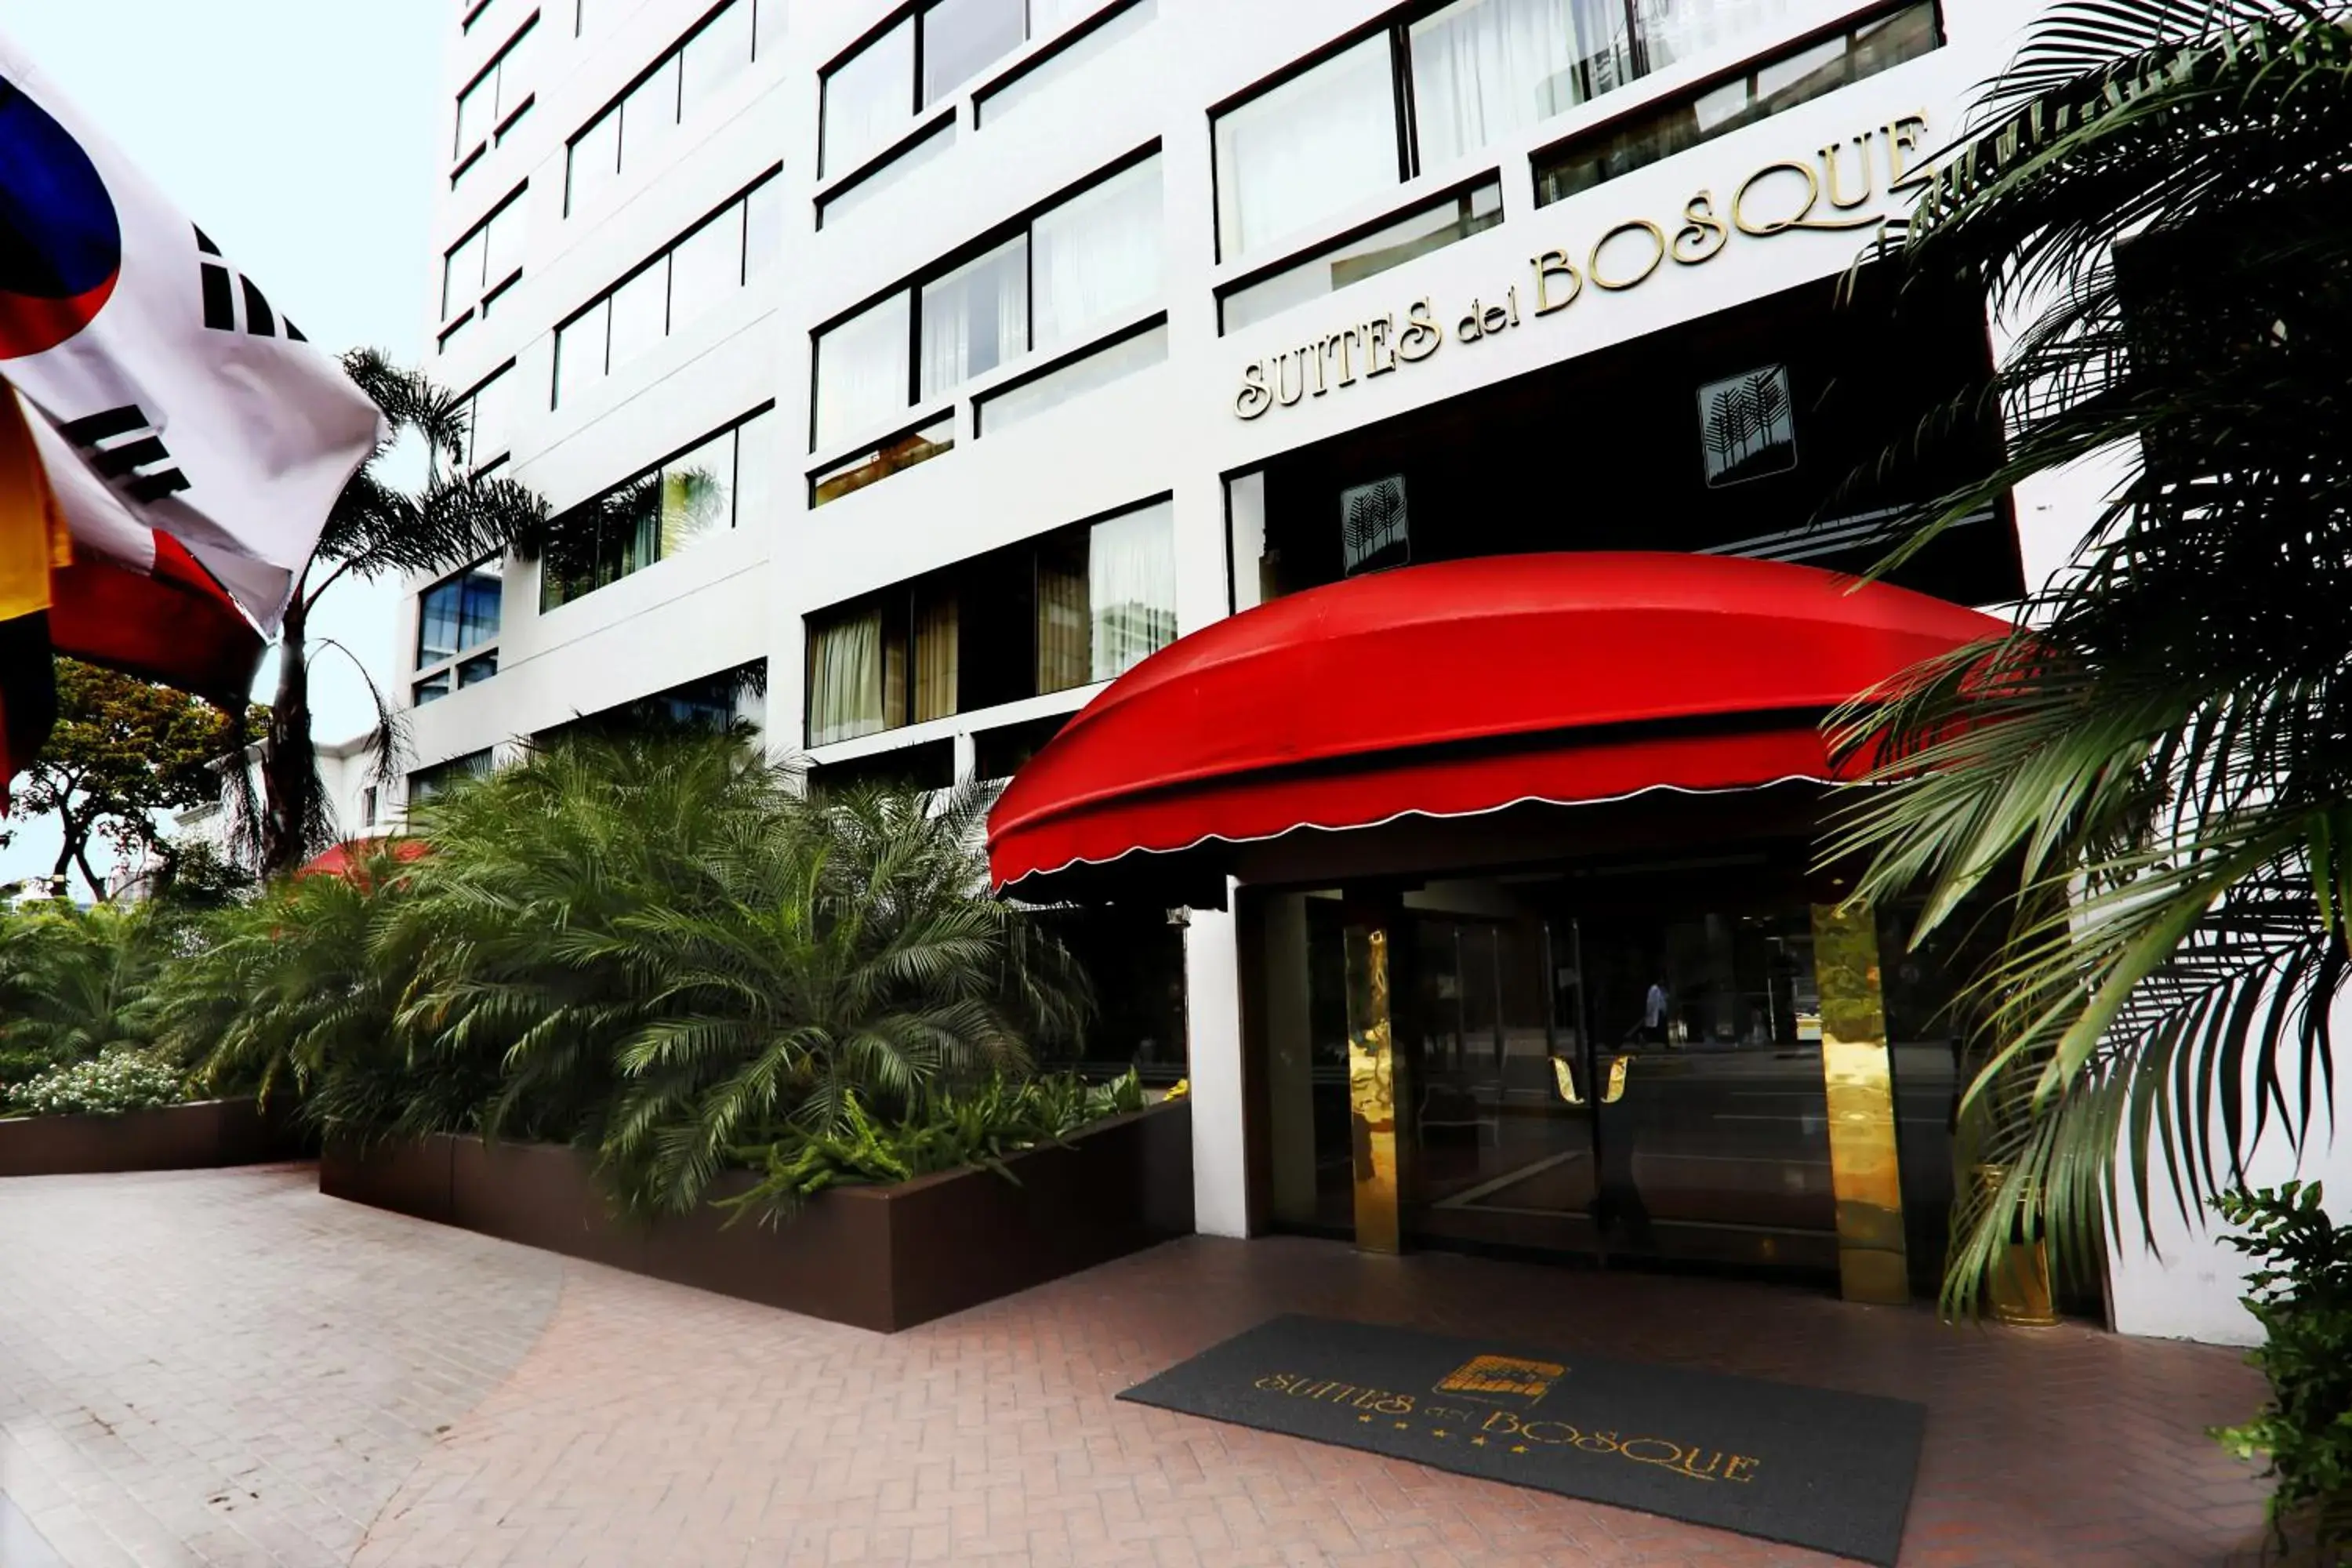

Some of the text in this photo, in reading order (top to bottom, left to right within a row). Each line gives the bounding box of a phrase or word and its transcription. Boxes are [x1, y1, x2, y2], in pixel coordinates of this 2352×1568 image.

[1233, 107, 1936, 420] SUITES del BOSQUE
[1254, 1374, 1415, 1414] SUITES
[1482, 1410, 1760, 1482] BOSQUE
